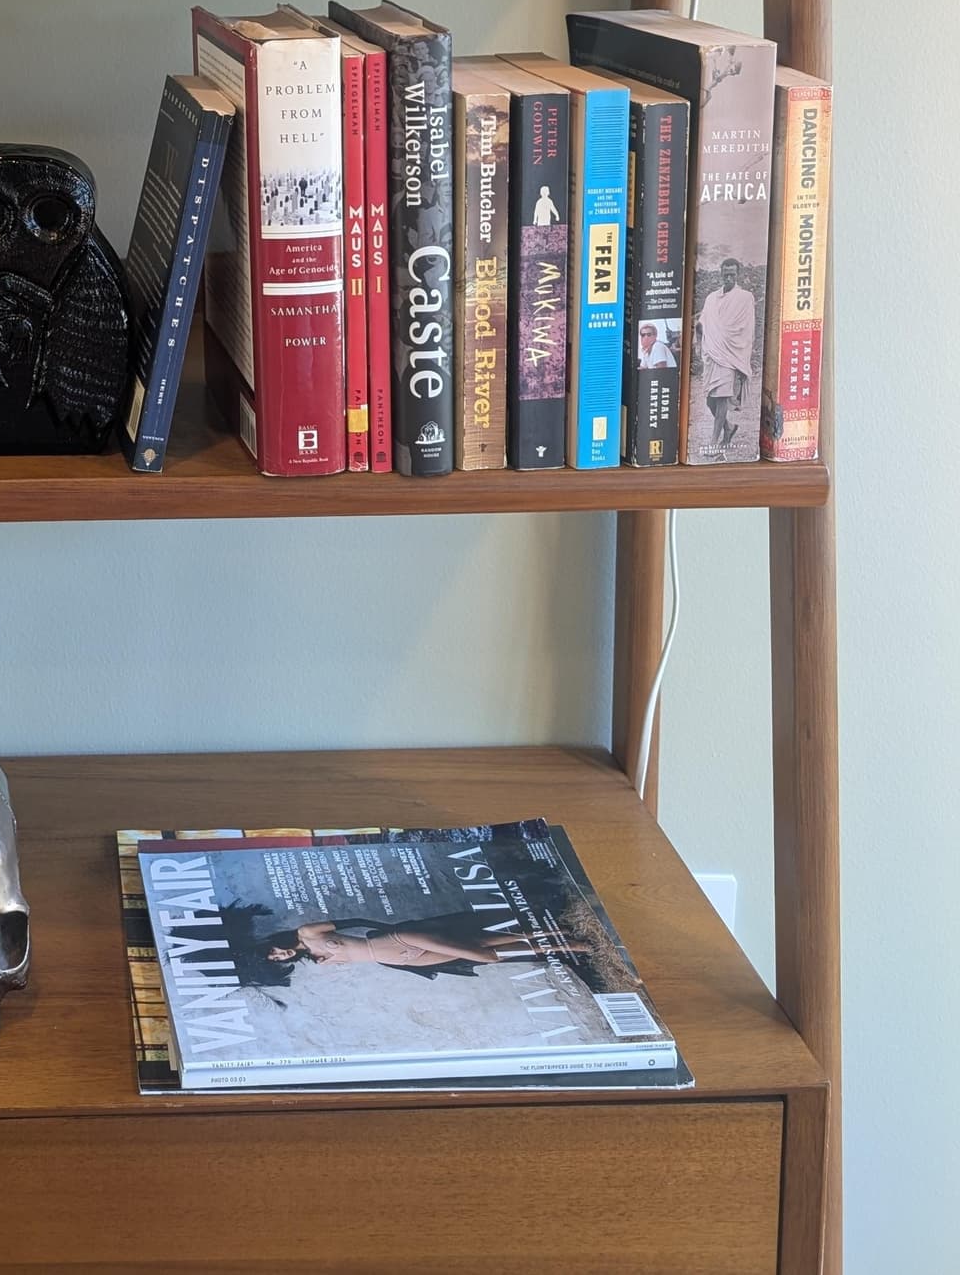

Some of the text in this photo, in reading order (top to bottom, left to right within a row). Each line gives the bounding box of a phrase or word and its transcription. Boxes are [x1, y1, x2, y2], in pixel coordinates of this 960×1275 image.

[266, 84, 336, 96] PROBLEM
[281, 108, 322, 119] FROM
[402, 82, 423, 206] Wilkerson
[429, 105, 447, 182] Isabel
[703, 143, 770, 153] MEREDITH
[712, 130, 761, 140] MARTIN
[801, 108, 818, 188] DANCING
[480, 115, 497, 243] Tim Butcher
[657, 116, 672, 264] THE ZANZIBAR CHEST
[701, 181, 767, 202] AFRICA
[349, 206, 363, 295] MAUS II
[371, 204, 384, 293] MAUS I
[594, 245, 610, 294] FEAR
[795, 215, 814, 311] MONSTERS
[271, 305, 338, 316] SAMANTHA
[285, 337, 326, 347] POWER
[407, 246, 451, 398] Caste
[472, 257, 497, 428] Blood River
[405, 848, 431, 895] BLACK PRESIDENT
[150, 856, 256, 1053] VANITY FAIR
